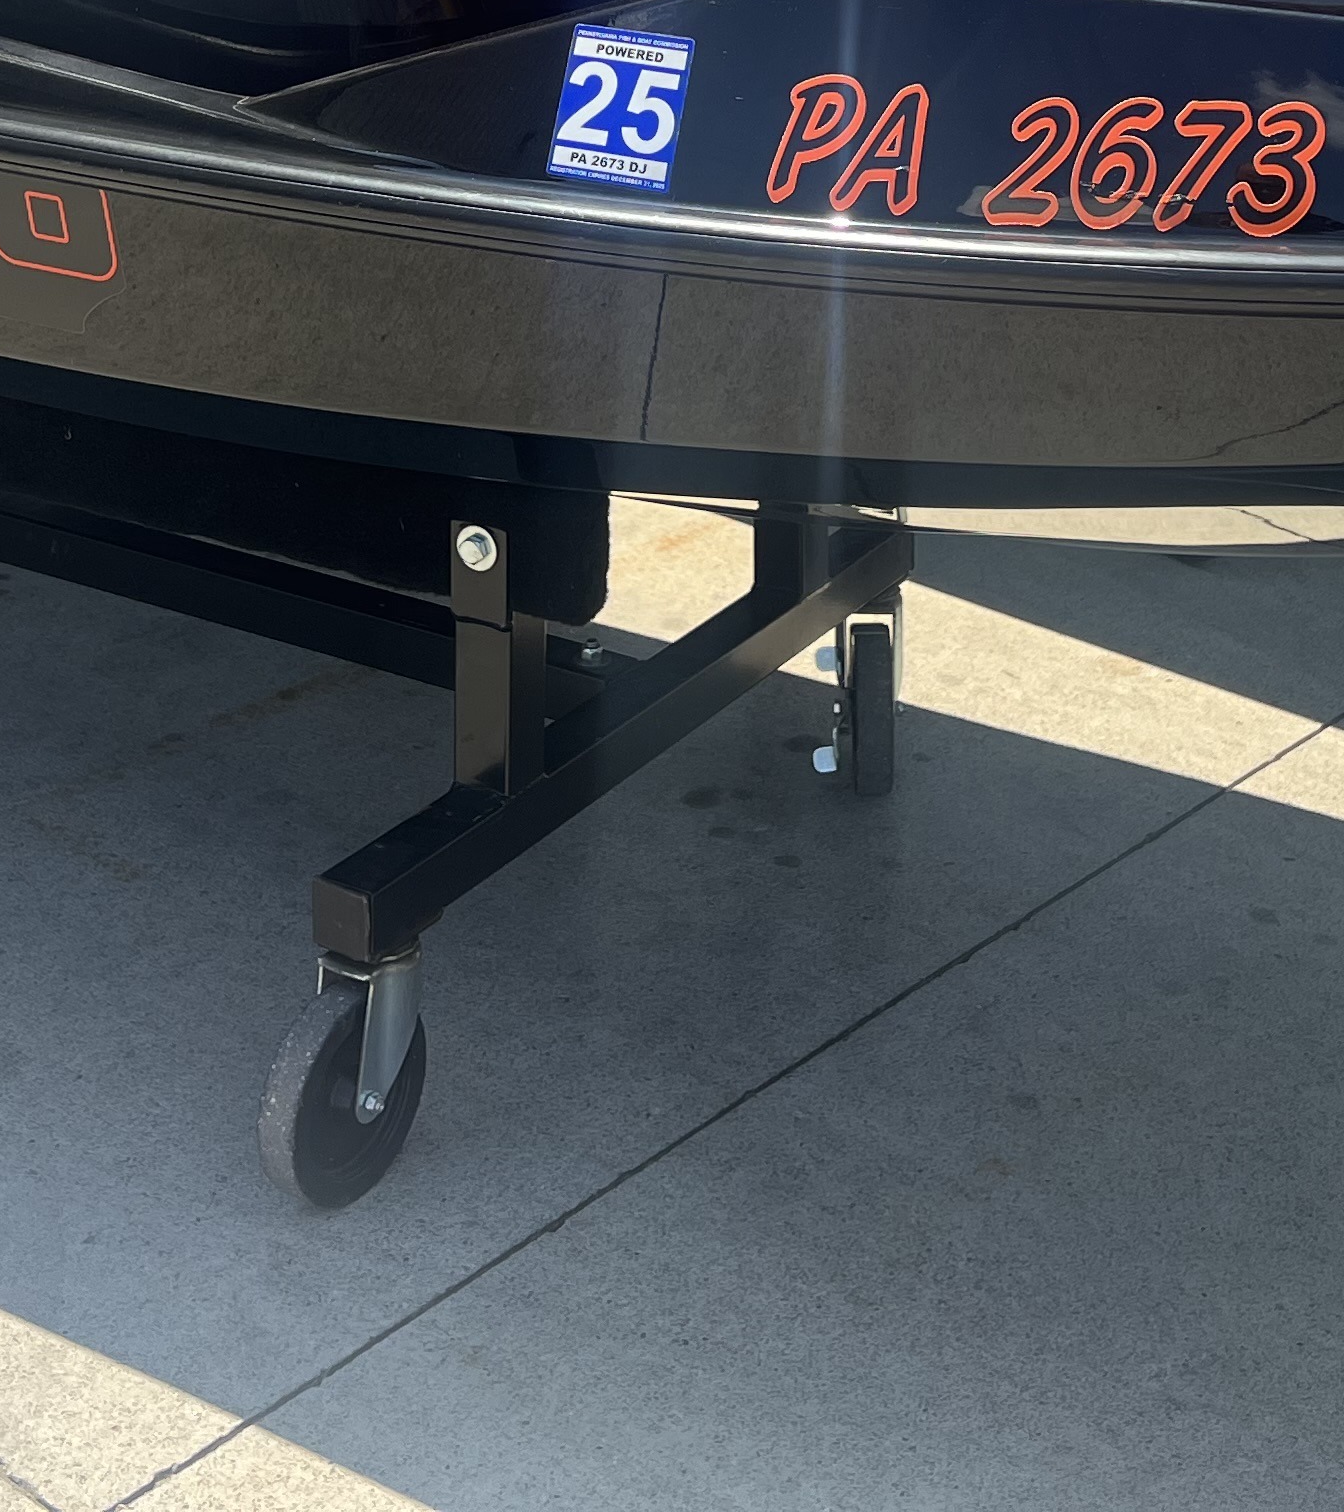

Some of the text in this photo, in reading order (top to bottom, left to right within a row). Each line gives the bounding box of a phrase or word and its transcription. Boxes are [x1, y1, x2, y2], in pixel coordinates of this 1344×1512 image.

[596, 43, 664, 63] POWERED
[556, 61, 681, 155] 25
[570, 152, 648, 175] PA 2673 DJ
[766, 73, 929, 216] PA
[981, 96, 1326, 239] 2673
